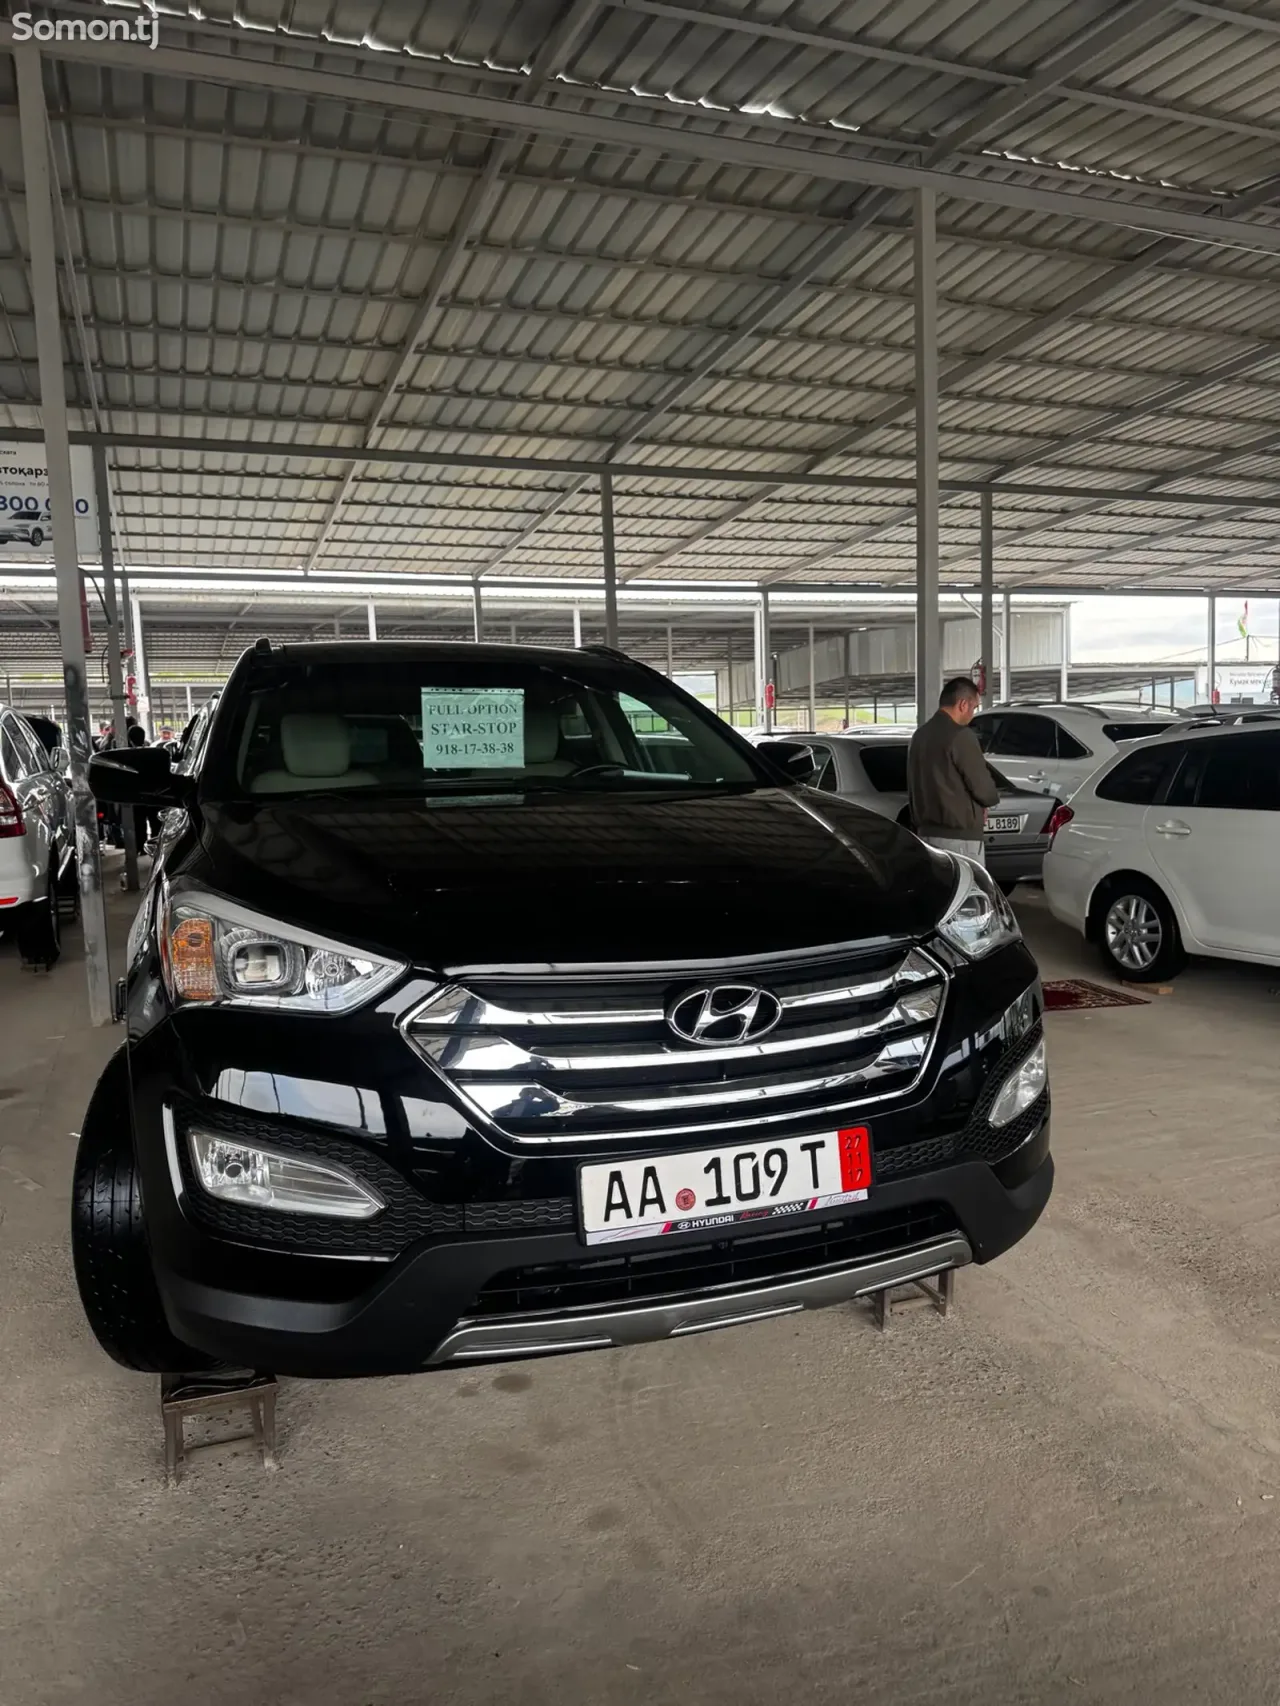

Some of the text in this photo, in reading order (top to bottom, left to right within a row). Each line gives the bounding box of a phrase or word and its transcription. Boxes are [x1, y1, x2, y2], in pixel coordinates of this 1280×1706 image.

[0, 466, 49, 479] тоқарз
[429, 703, 518, 716] FULL OPTION
[431, 722, 517, 736] STAR-STOP
[436, 742, 514, 755] 918-17-38-38
[995, 818, 1018, 830] 8189
[603, 1139, 825, 1223] AA 109 T
[692, 1214, 734, 1228] HYUNDAI
